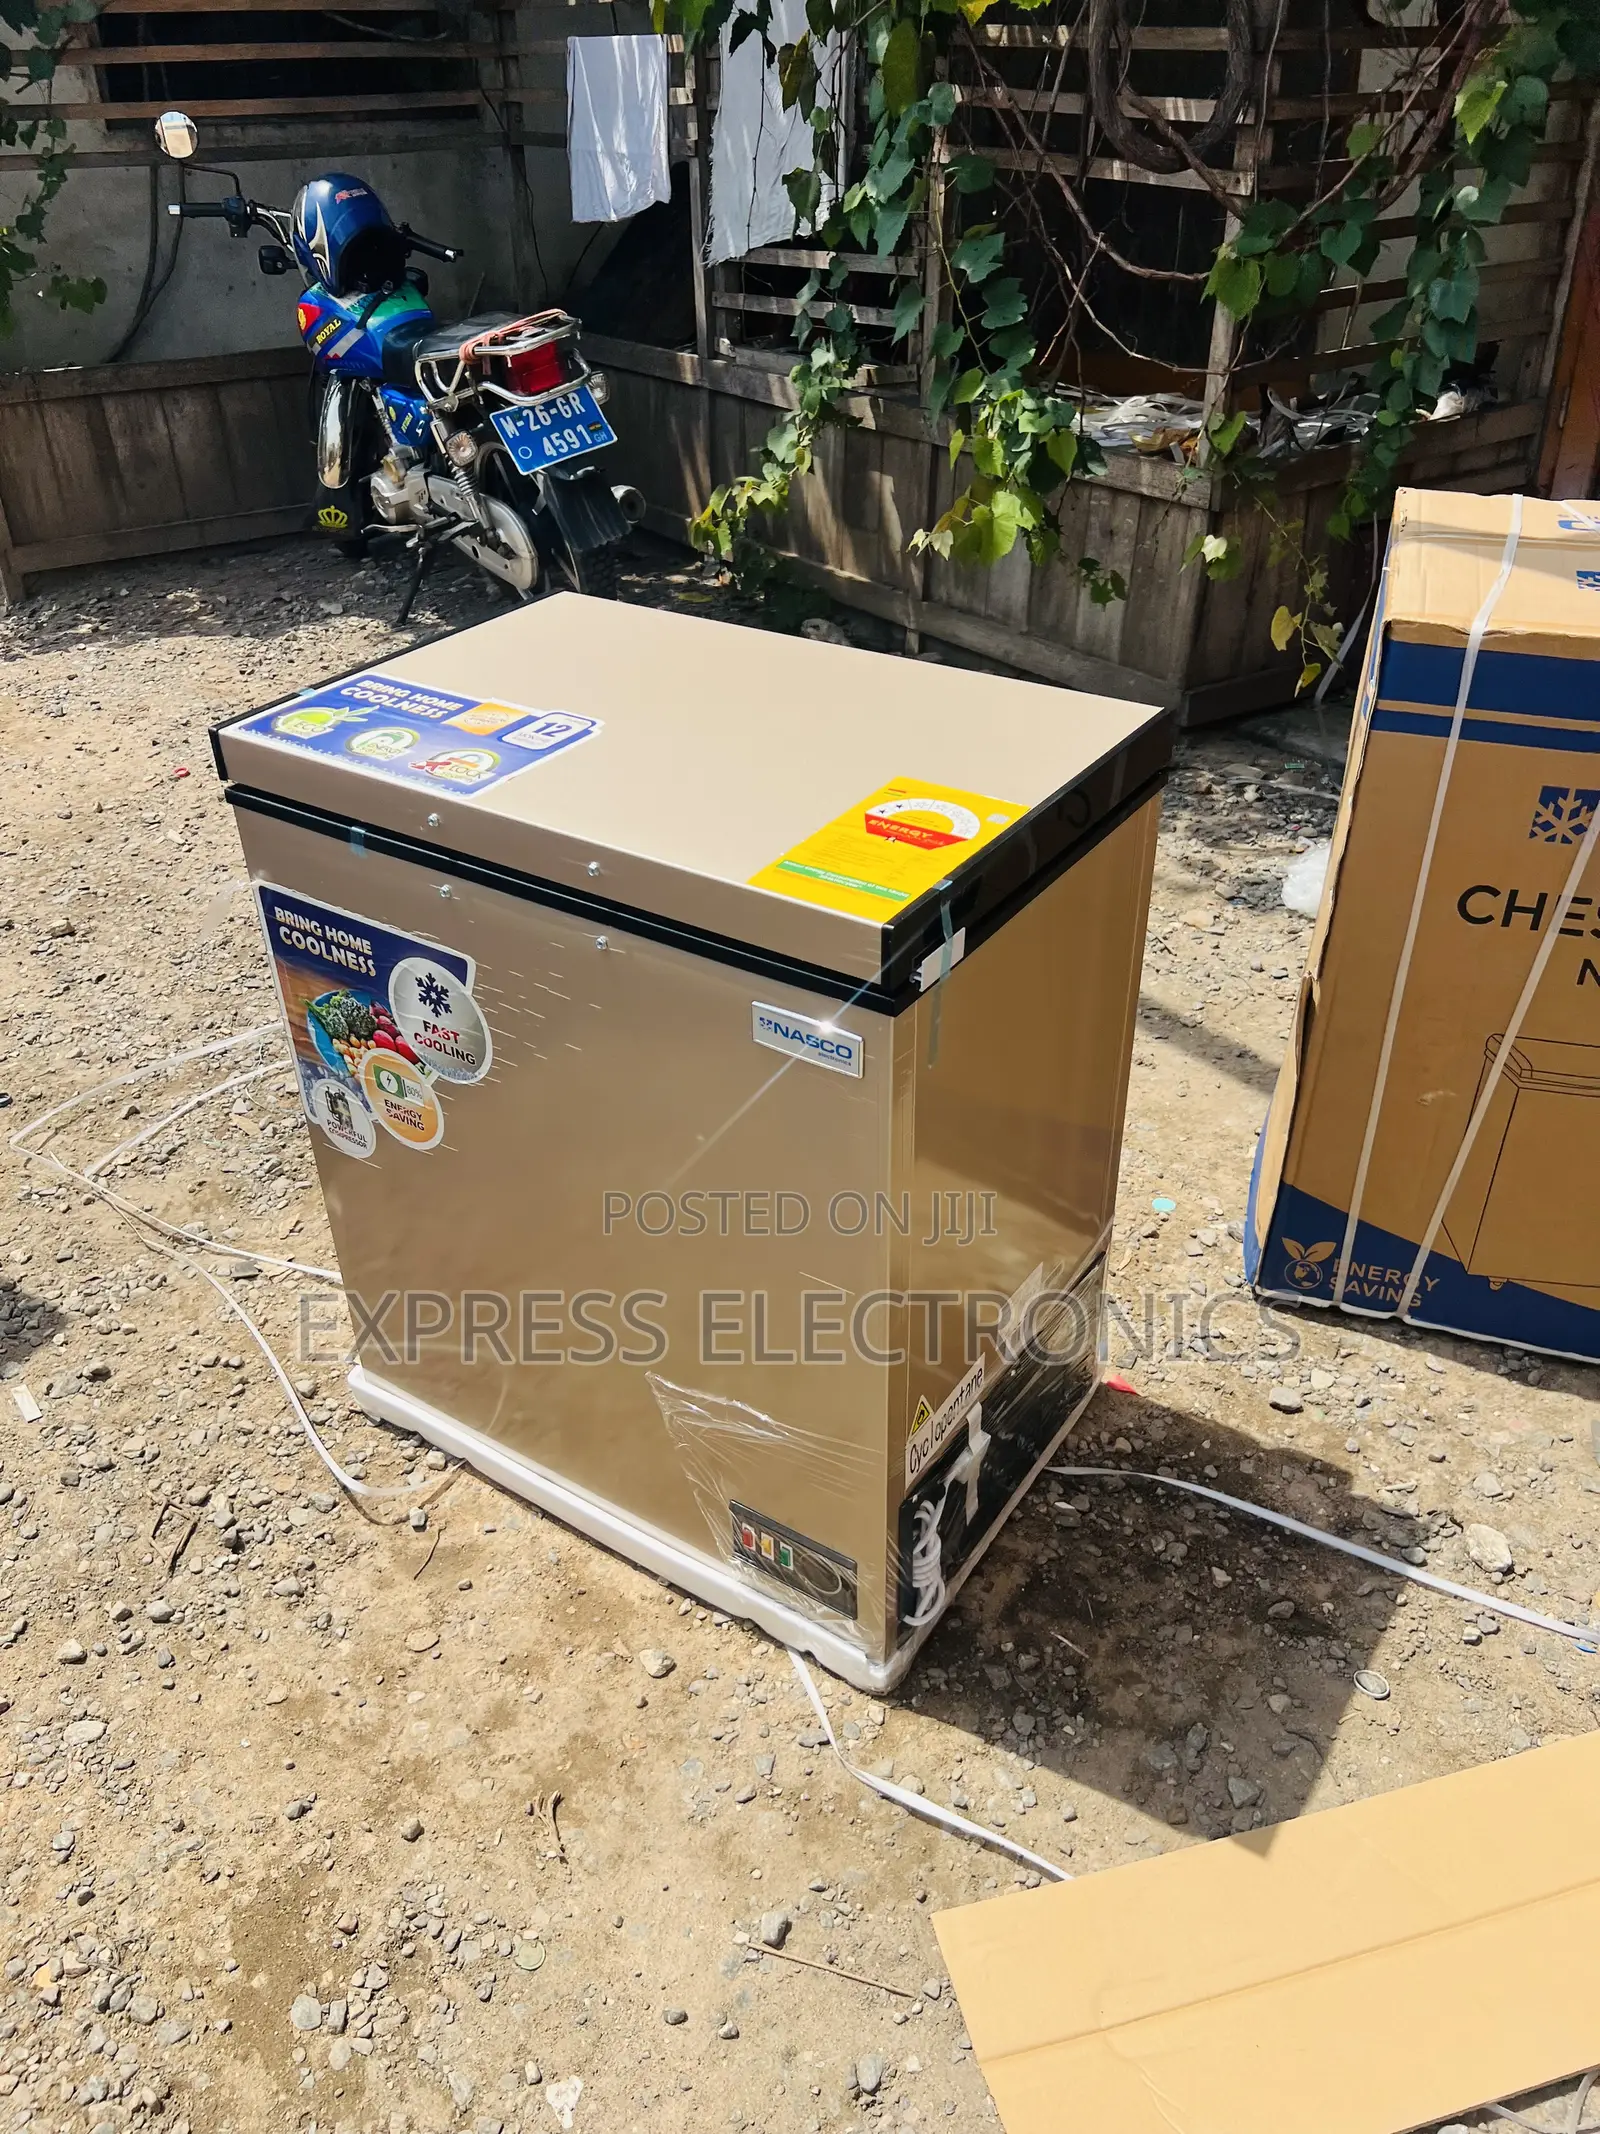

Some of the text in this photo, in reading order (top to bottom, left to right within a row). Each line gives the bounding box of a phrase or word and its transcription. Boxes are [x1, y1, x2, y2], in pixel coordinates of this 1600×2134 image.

[316, 319, 341, 344] ROYAL
[542, 424, 592, 457] 4591
[593, 431, 608, 442] GH
[341, 687, 449, 719] COOLNESS
[356, 680, 464, 711] BRING HOME
[533, 722, 572, 738] 12
[868, 819, 933, 838] ENERGY
[1457, 885, 1600, 939] CHE
[274, 906, 373, 956] BRING HOME
[279, 926, 377, 977] COOLNESS
[423, 1019, 460, 1044] FAST
[774, 1022, 852, 1060] NASCO
[413, 1032, 476, 1066] COOLING
[384, 1099, 422, 1121] ENERGY
[386, 1108, 425, 1131] SAVING
[909, 1367, 983, 1474] Cyclopentane
